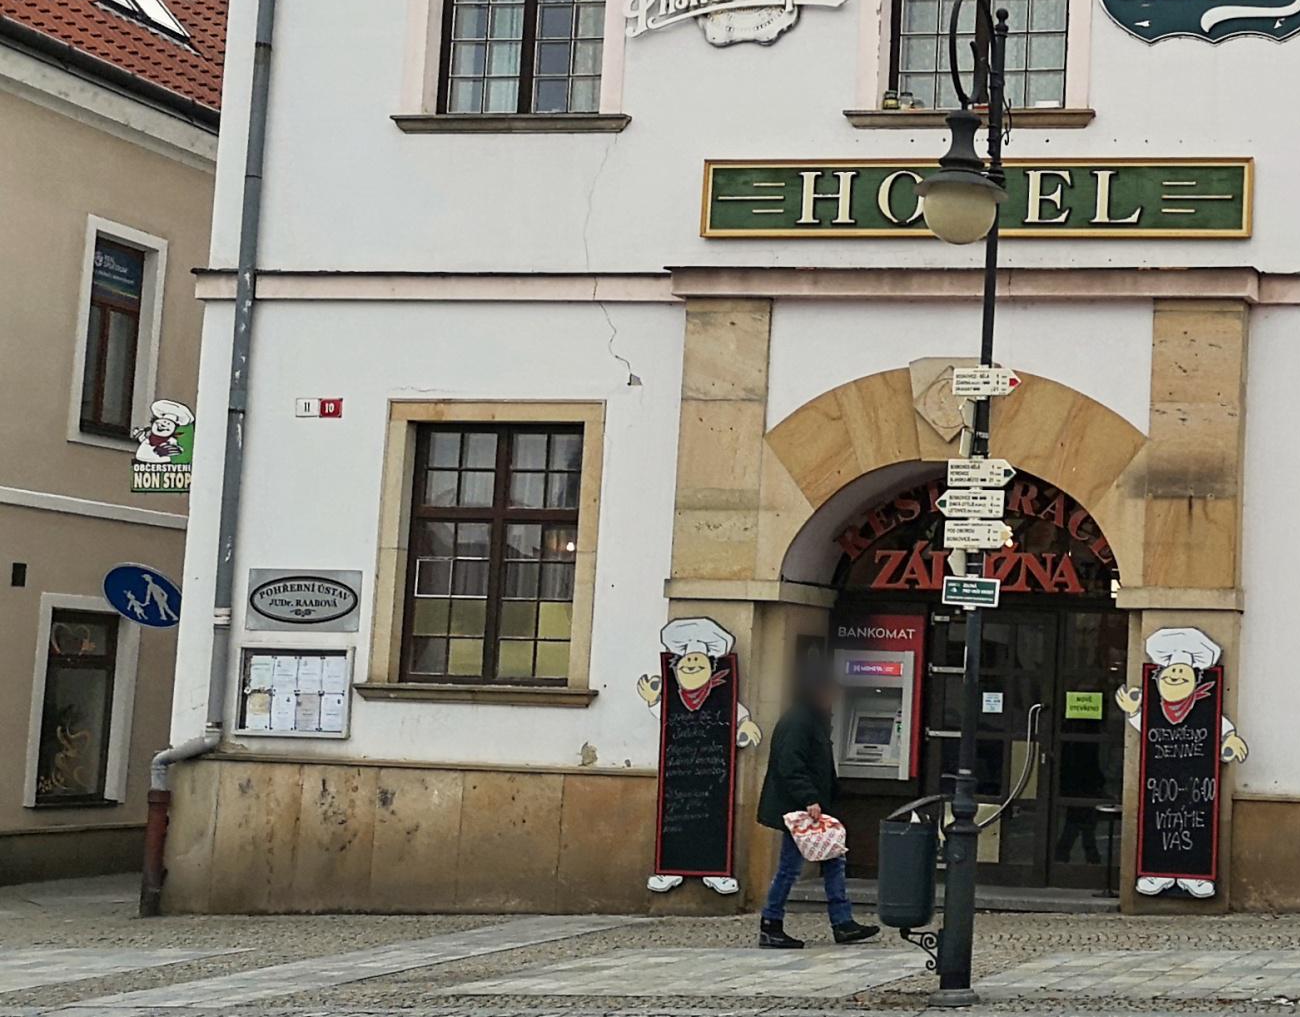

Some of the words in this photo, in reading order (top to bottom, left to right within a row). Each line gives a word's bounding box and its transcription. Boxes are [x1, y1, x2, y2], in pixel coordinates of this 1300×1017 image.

[796, 170, 1143, 225] HOEL
[304, 401, 310, 413] 11
[324, 402, 335, 414] 10
[134, 472, 160, 488] NON
[163, 472, 193, 489] STOP
[870, 539, 1085, 594] ZÁLŽNA
[259, 583, 316, 600] POHŘEBNÍ
[317, 584, 351, 601] ÚSTAV
[295, 599, 338, 608] RAABOVÁ
[838, 626, 916, 640] BANKOMAT
